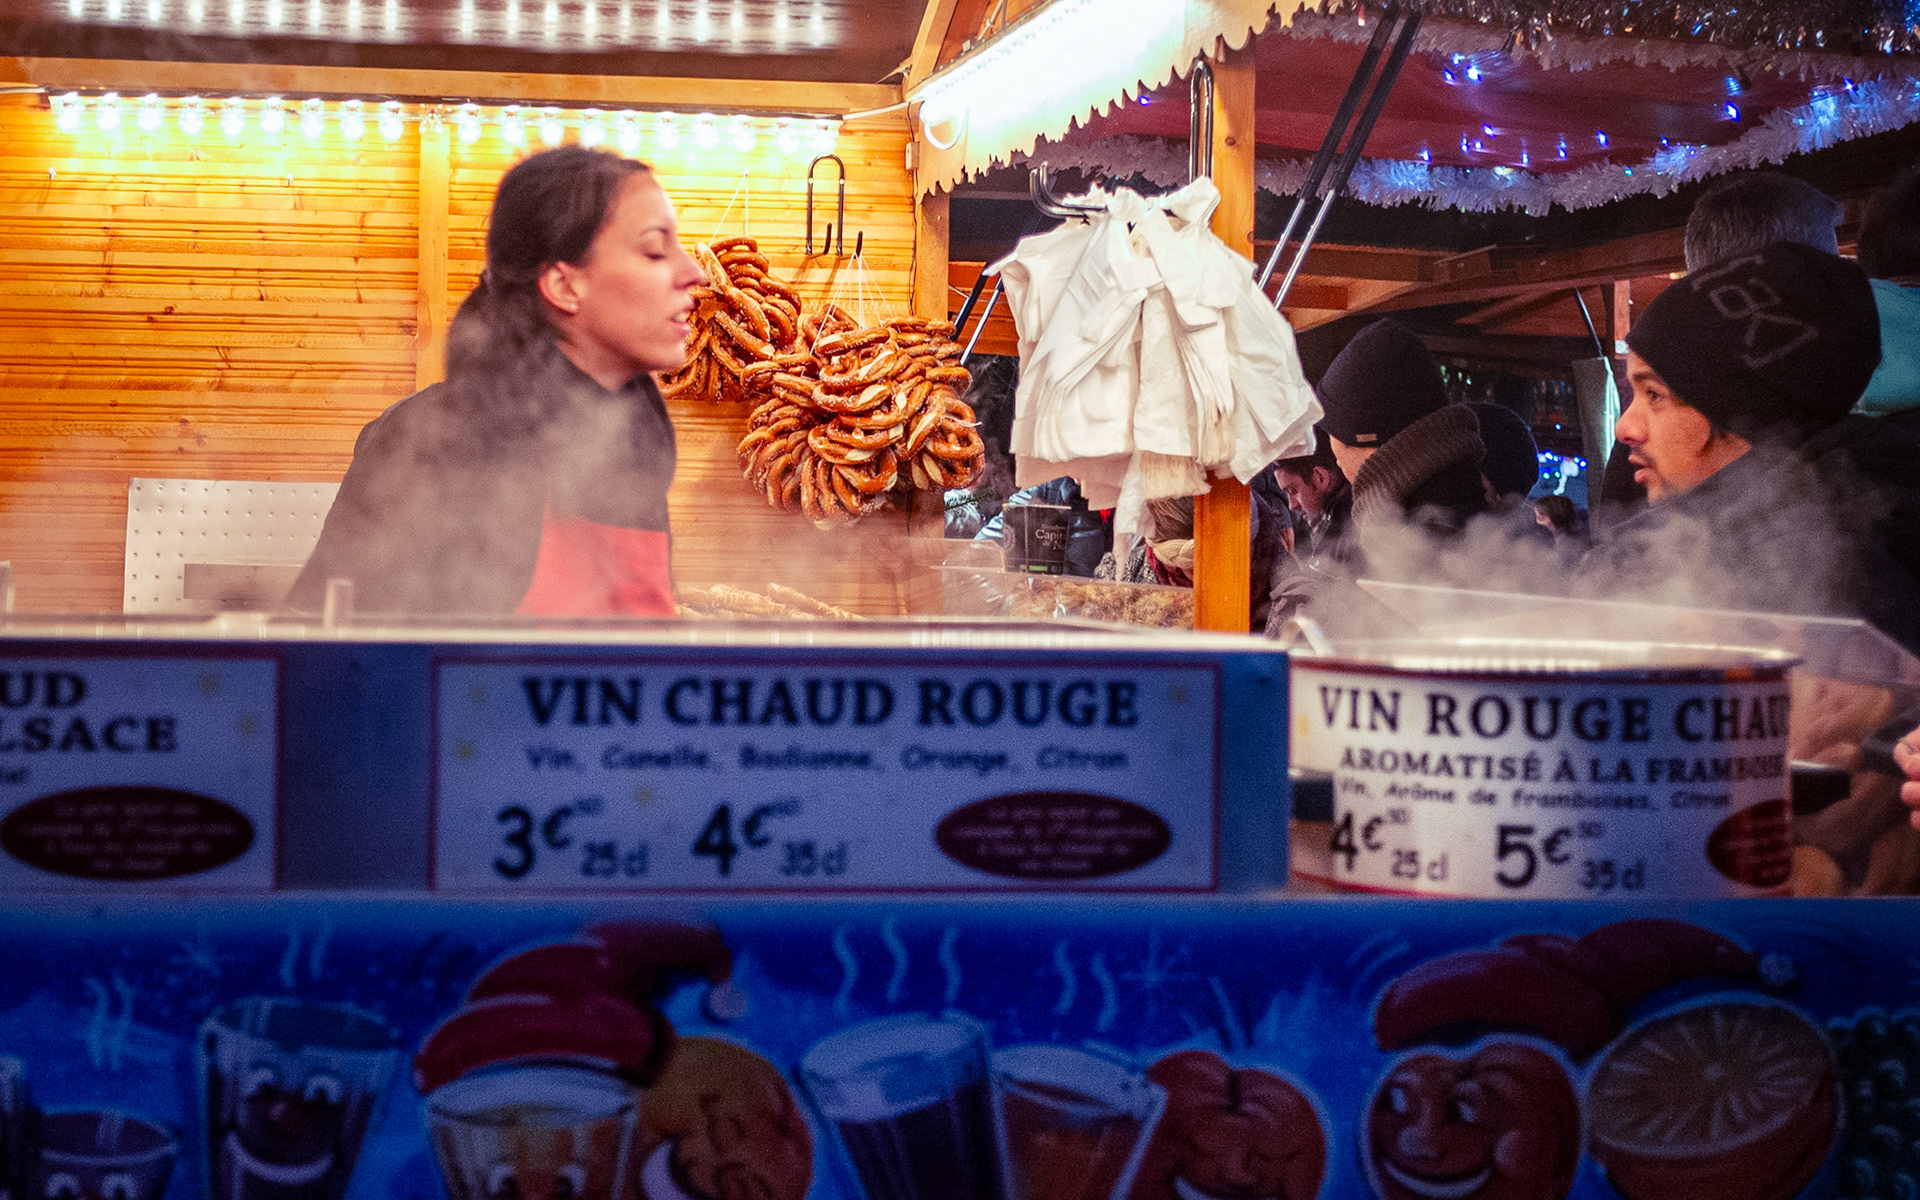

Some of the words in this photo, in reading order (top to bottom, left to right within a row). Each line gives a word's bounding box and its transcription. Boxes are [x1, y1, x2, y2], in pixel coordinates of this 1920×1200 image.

[0, 671, 87, 708] UD
[521, 676, 644, 725] VIN
[663, 678, 897, 727] CHAUD
[915, 679, 1139, 728] ROUGE
[1319, 684, 1400, 732] VIN
[1425, 692, 1651, 742] ROUGE
[1036, 745, 1128, 769] Citron
[1341, 747, 1543, 783] AROMATISÉ
[1553, 751, 1577, 783] À
[1589, 758, 1635, 784] LA
[1385, 782, 1455, 804] Arôme
[1468, 788, 1498, 806] de
